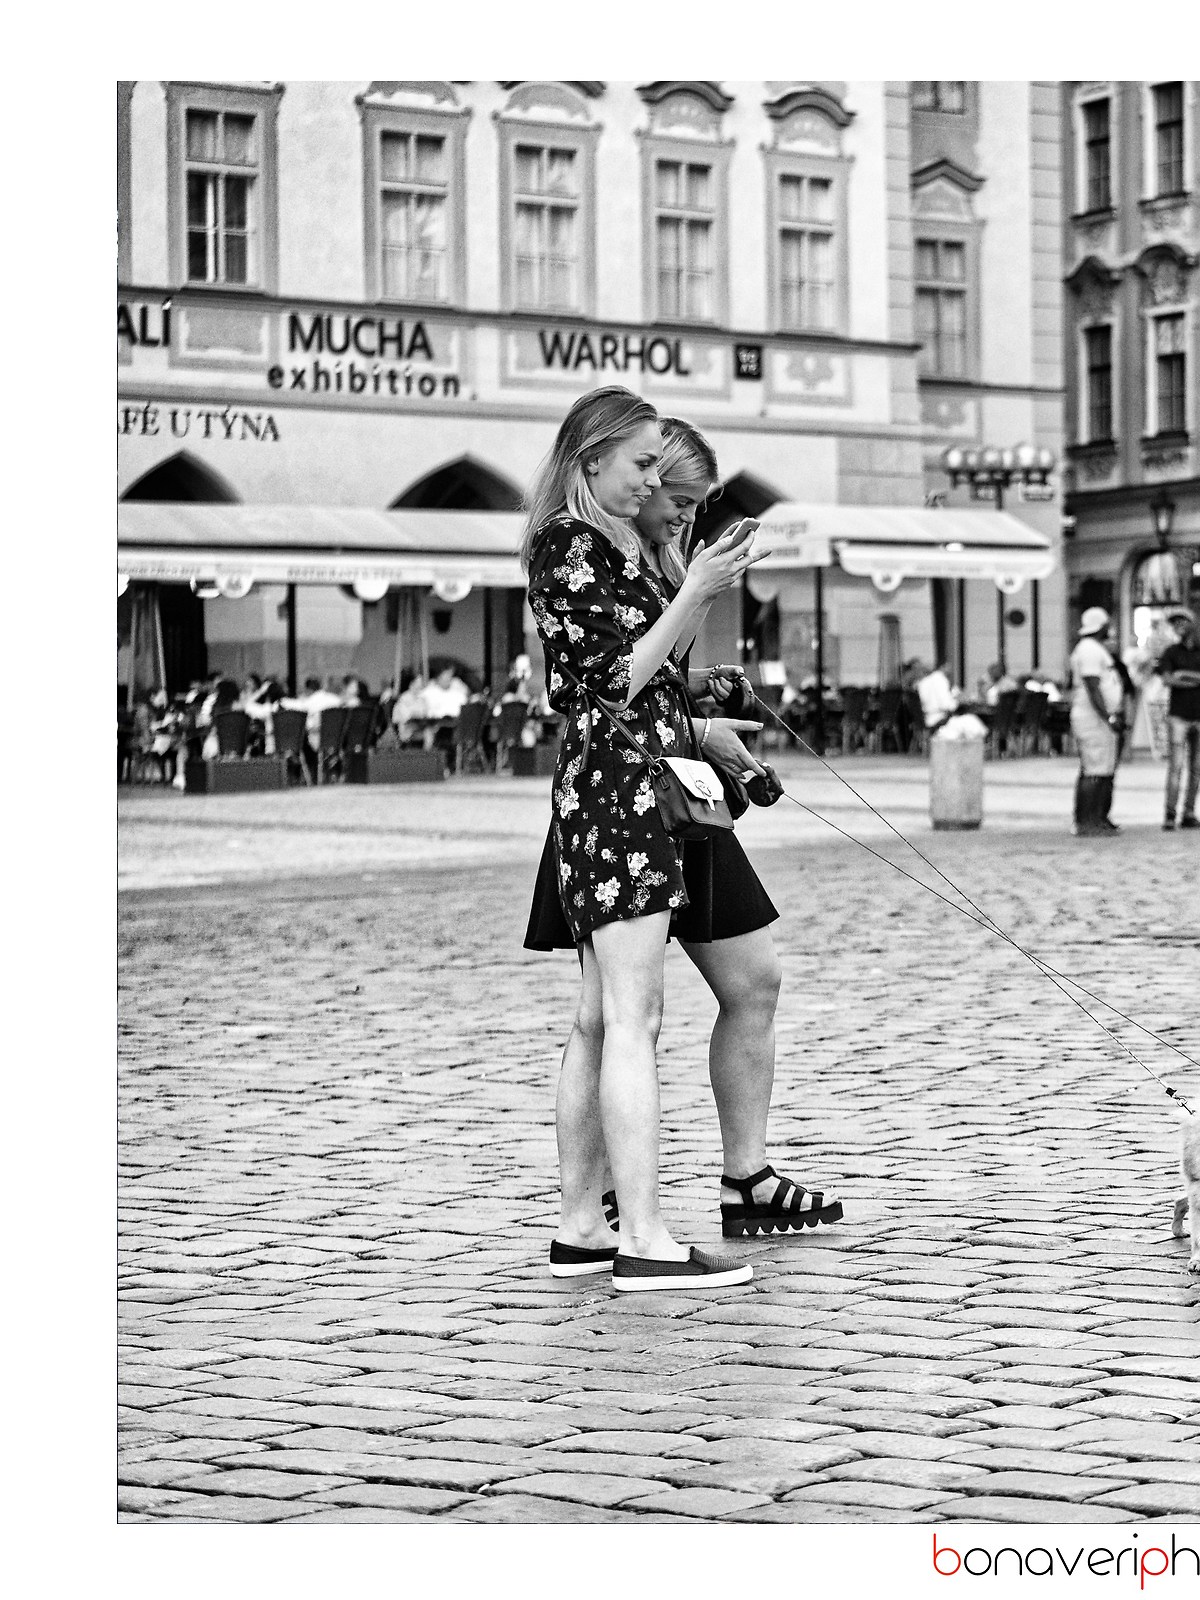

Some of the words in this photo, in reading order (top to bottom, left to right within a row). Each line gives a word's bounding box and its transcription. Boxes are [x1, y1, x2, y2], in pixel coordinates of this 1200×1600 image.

[288, 313, 434, 361] MUCHA
[539, 330, 690, 376] WARHOL
[267, 361, 461, 398] exhibition
[119, 400, 160, 437] FÉ
[170, 410, 192, 438] U
[197, 404, 282, 442] TÝNA
